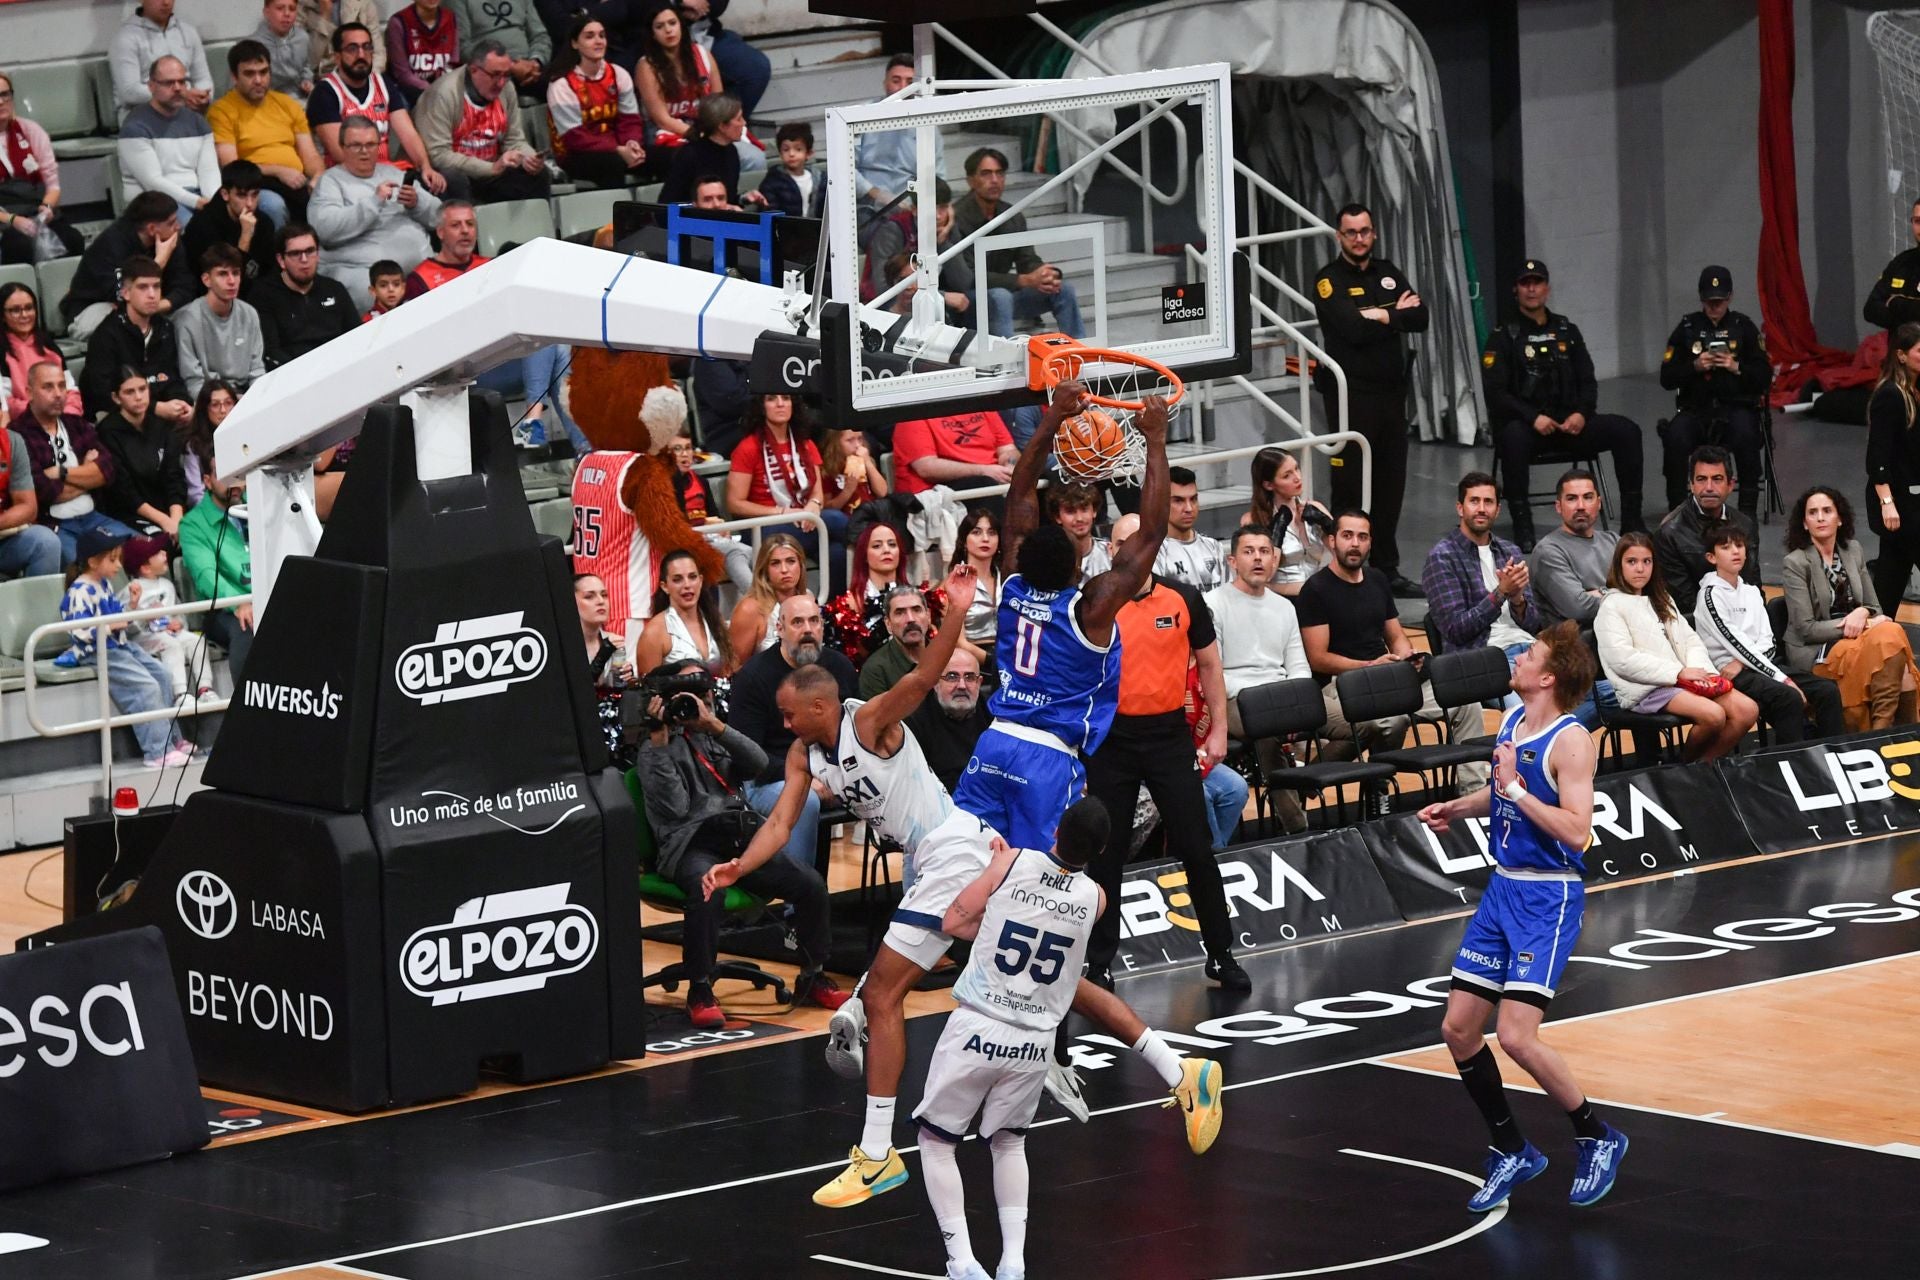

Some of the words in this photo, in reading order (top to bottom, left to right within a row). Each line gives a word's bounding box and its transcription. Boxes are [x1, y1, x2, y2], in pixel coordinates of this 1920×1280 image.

[1164, 297, 1183, 310] liga
[1164, 307, 1204, 320] endesa
[1007, 690, 1044, 706] MURCI
[390, 806, 429, 827] Uno
[435, 799, 469, 820] más
[474, 795, 493, 814] de
[497, 793, 512, 811] la
[516, 782, 578, 812] familia
[252, 900, 326, 940] LABASA
[994, 918, 1076, 986] 55
[188, 970, 334, 1041] BEYOND
[646, 1029, 755, 1052] acb
